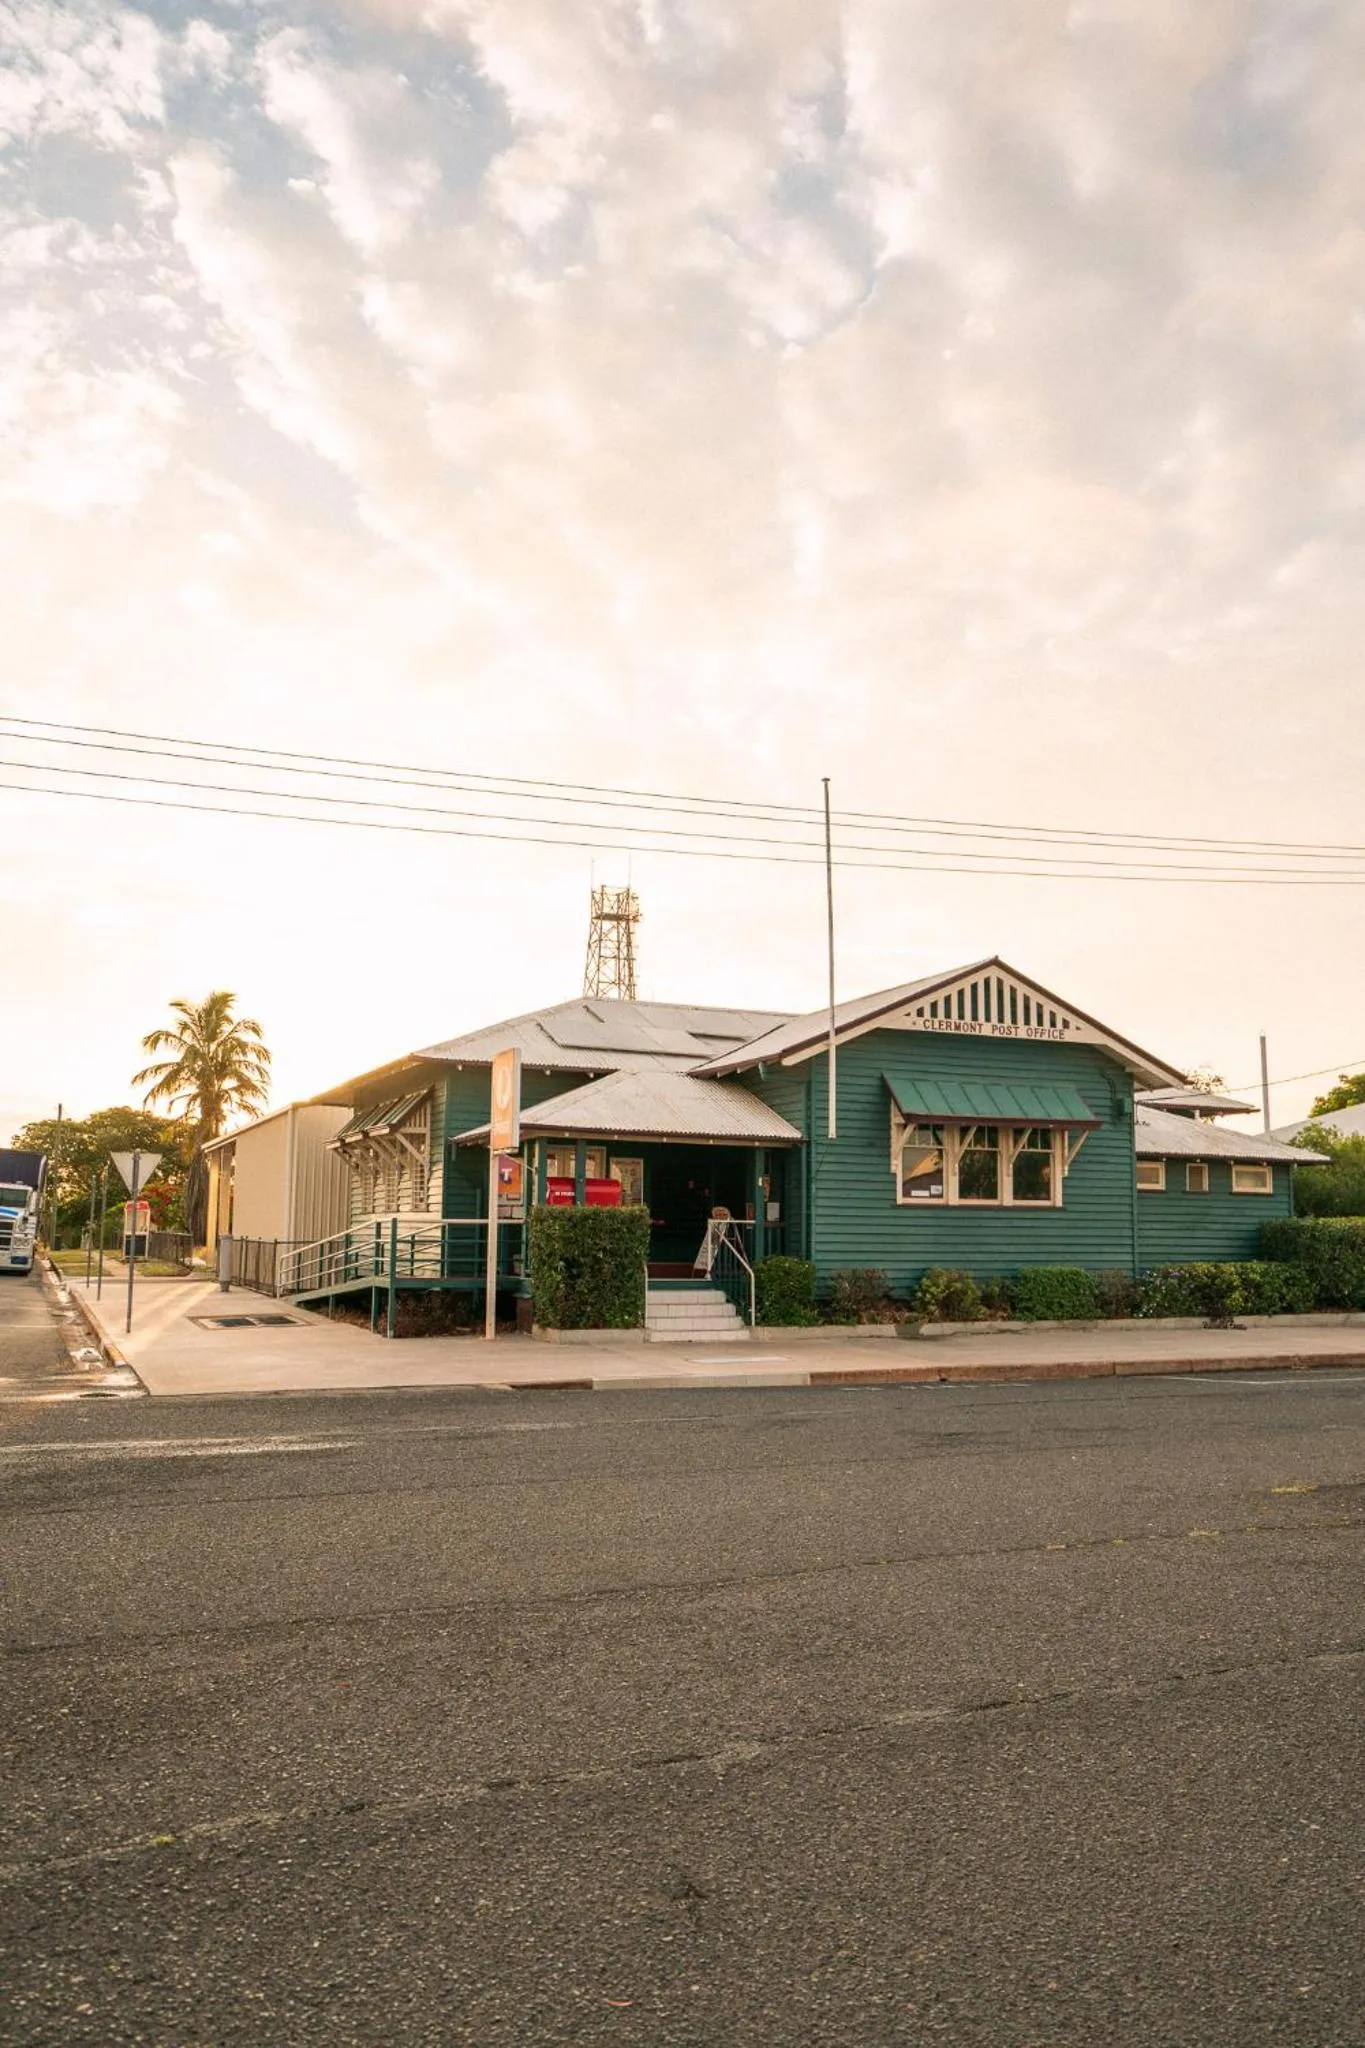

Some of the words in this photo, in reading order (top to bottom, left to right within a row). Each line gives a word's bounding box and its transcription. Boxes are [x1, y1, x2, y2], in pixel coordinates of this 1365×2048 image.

[923, 1018, 984, 1033] CLERMONT
[992, 1025, 1021, 1036] POST
[1026, 1027, 1066, 1039] OFFICE
